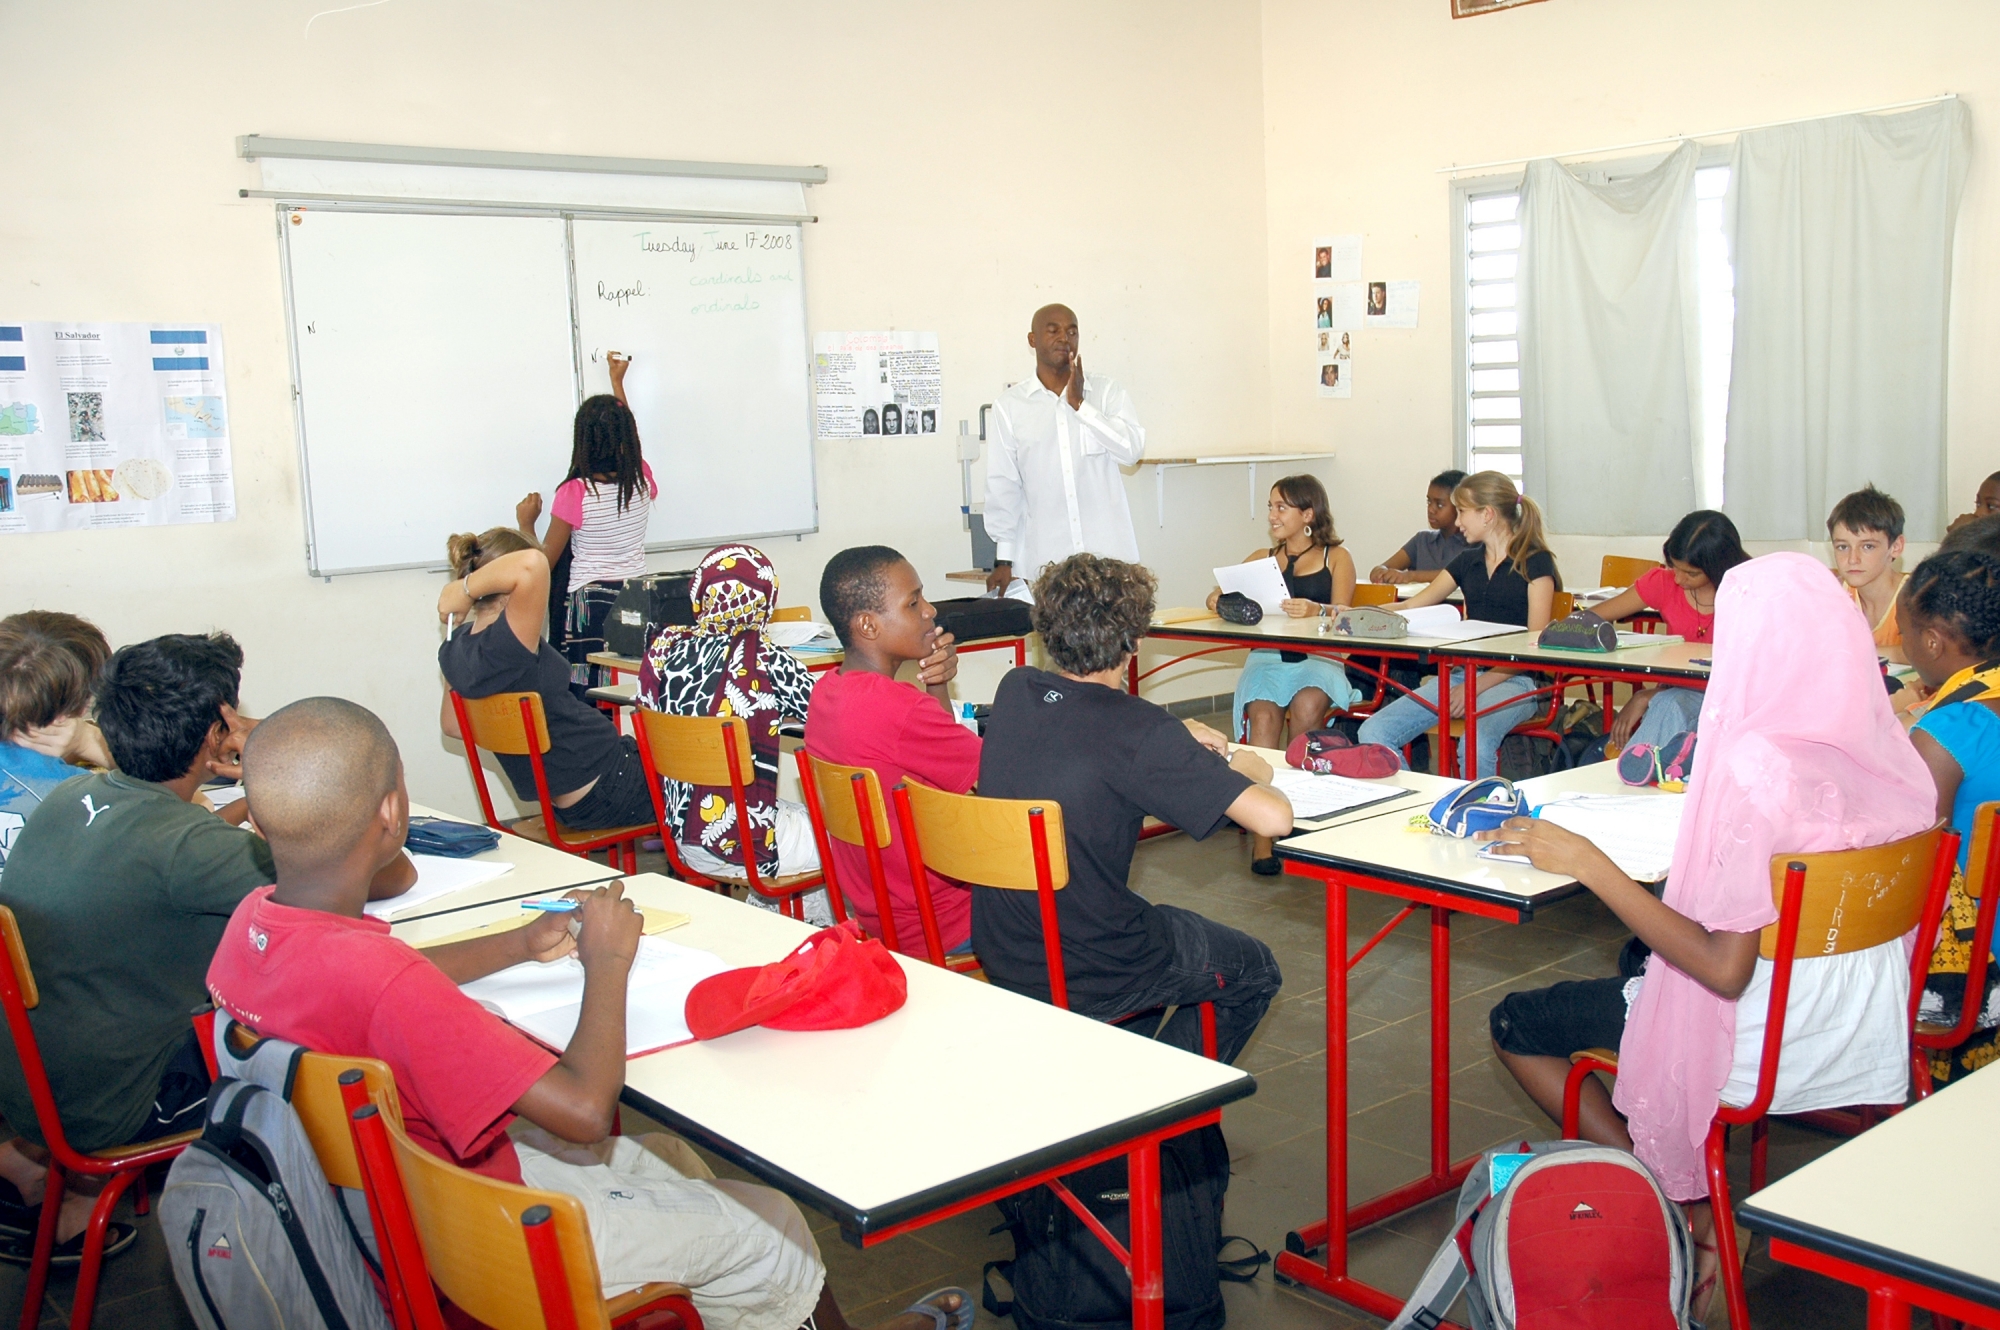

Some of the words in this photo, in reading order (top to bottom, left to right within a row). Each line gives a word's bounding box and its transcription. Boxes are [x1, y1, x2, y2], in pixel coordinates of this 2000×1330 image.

[745, 232, 758, 249] 17
[760, 234, 793, 250] 2008
[690, 267, 762, 286] cardinals
[769, 270, 793, 282] and
[691, 294, 760, 315] ordinals
[55, 331, 63, 340] El
[65, 331, 101, 340] Salvador
